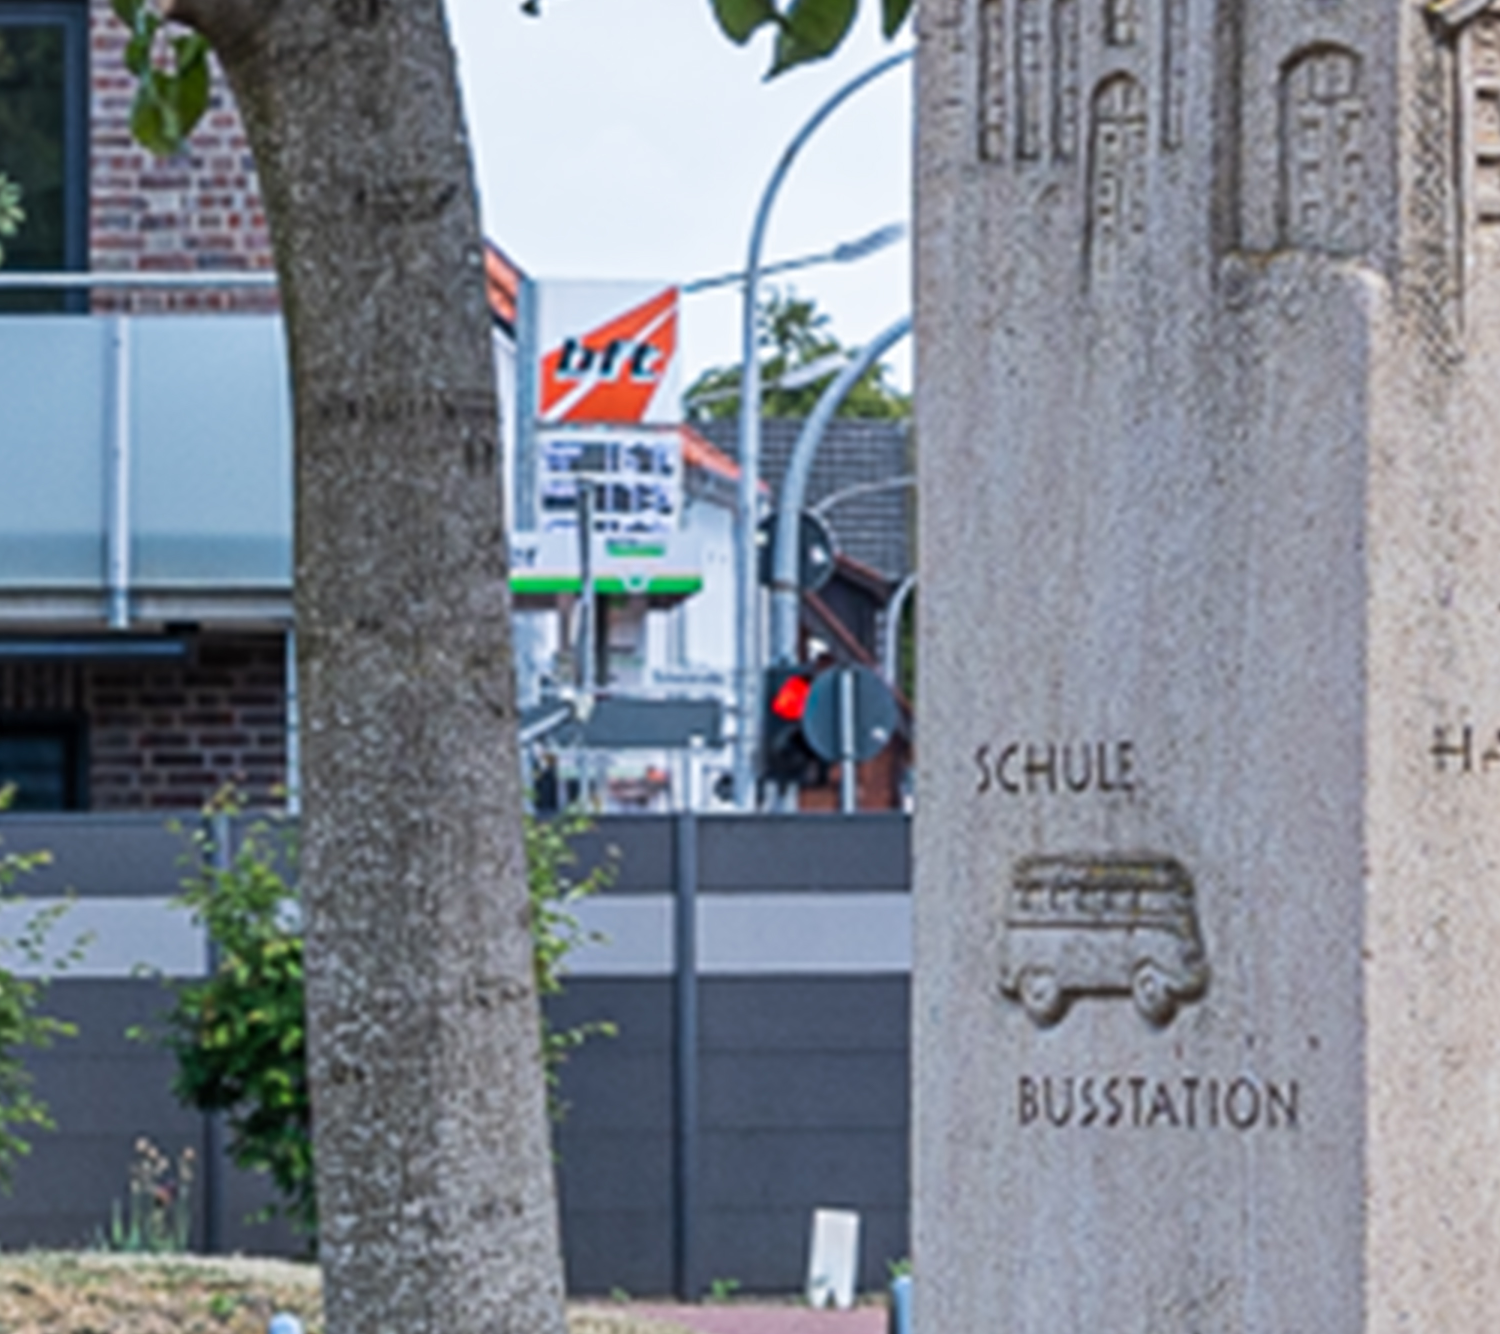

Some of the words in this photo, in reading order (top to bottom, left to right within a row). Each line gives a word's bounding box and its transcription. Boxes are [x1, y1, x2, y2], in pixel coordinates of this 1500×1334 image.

[555, 337, 658, 380] bft
[975, 741, 1136, 793] SCHULE
[1017, 1075, 1300, 1130] BUSSTATION
